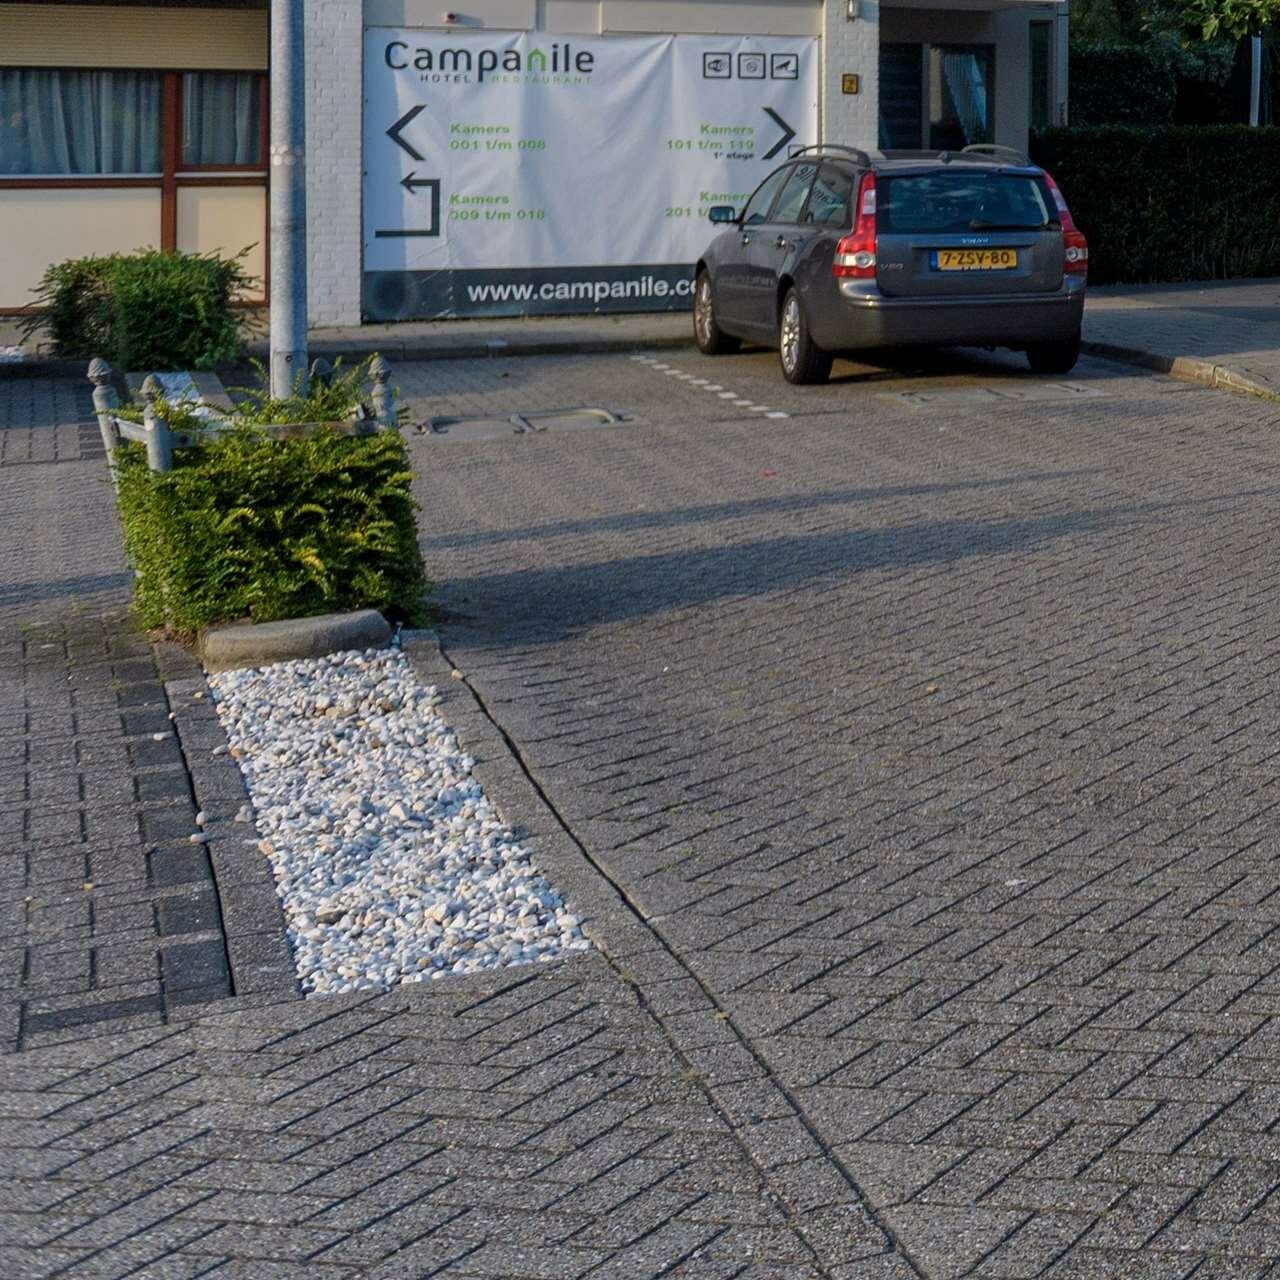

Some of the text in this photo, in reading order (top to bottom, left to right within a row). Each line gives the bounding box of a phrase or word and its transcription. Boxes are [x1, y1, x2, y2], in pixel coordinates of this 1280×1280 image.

[384, 41, 594, 82] Campanile
[420, 75, 471, 83] HOTEL
[450, 123, 510, 134] Kamers
[700, 124, 753, 134] Kamers
[450, 140, 478, 150] 001
[667, 140, 691, 149] 101
[450, 193, 510, 204] Kamers
[665, 208, 691, 217] 201
